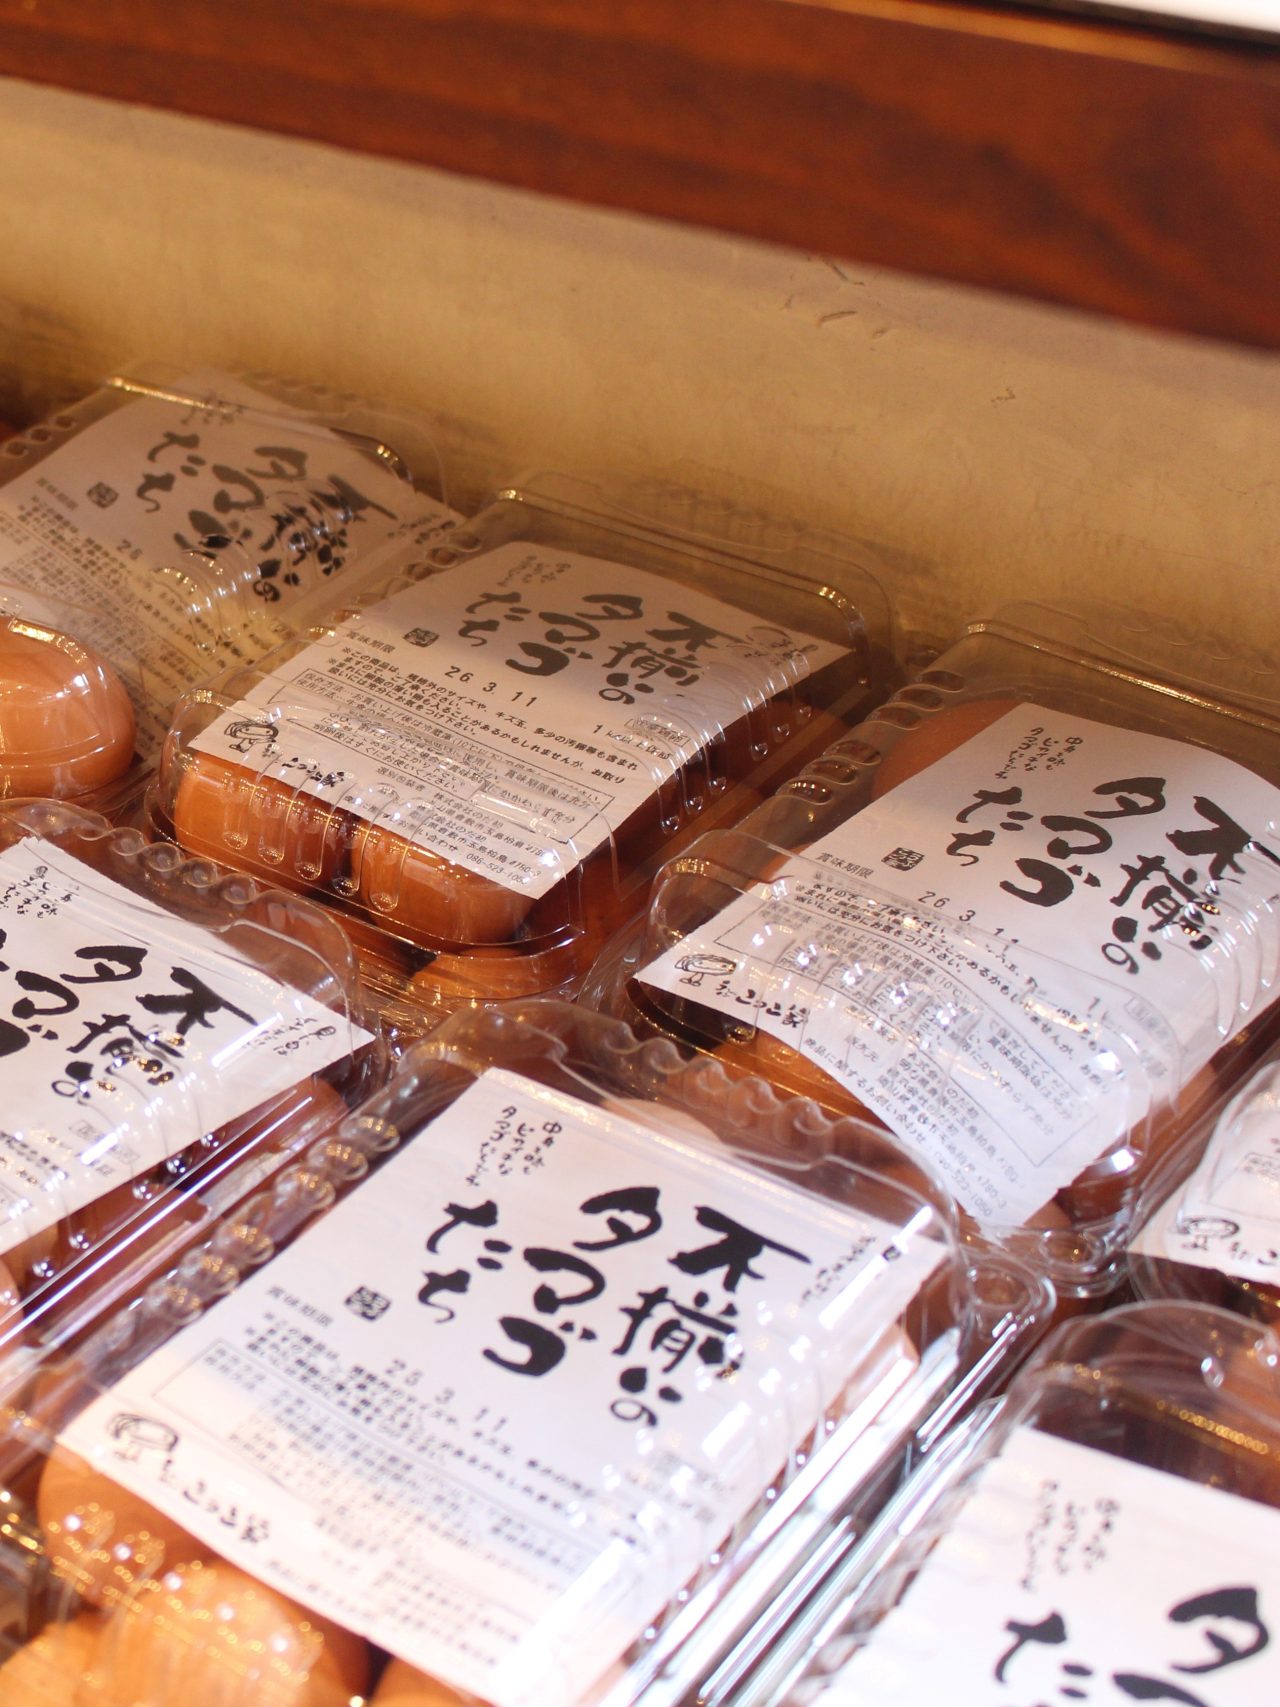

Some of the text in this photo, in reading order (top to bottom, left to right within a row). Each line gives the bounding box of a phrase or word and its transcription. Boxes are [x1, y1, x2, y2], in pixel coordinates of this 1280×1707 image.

[459, 592, 531, 647] たち
[505, 594, 643, 676] タマゴ
[598, 611, 745, 705] 不揃いの
[949, 786, 1034, 867] たち
[999, 777, 1166, 907] タマゴ
[423, 1199, 513, 1323] たち
[482, 1186, 663, 1378] タマゴ
[610, 1205, 812, 1428] 不揃いの
